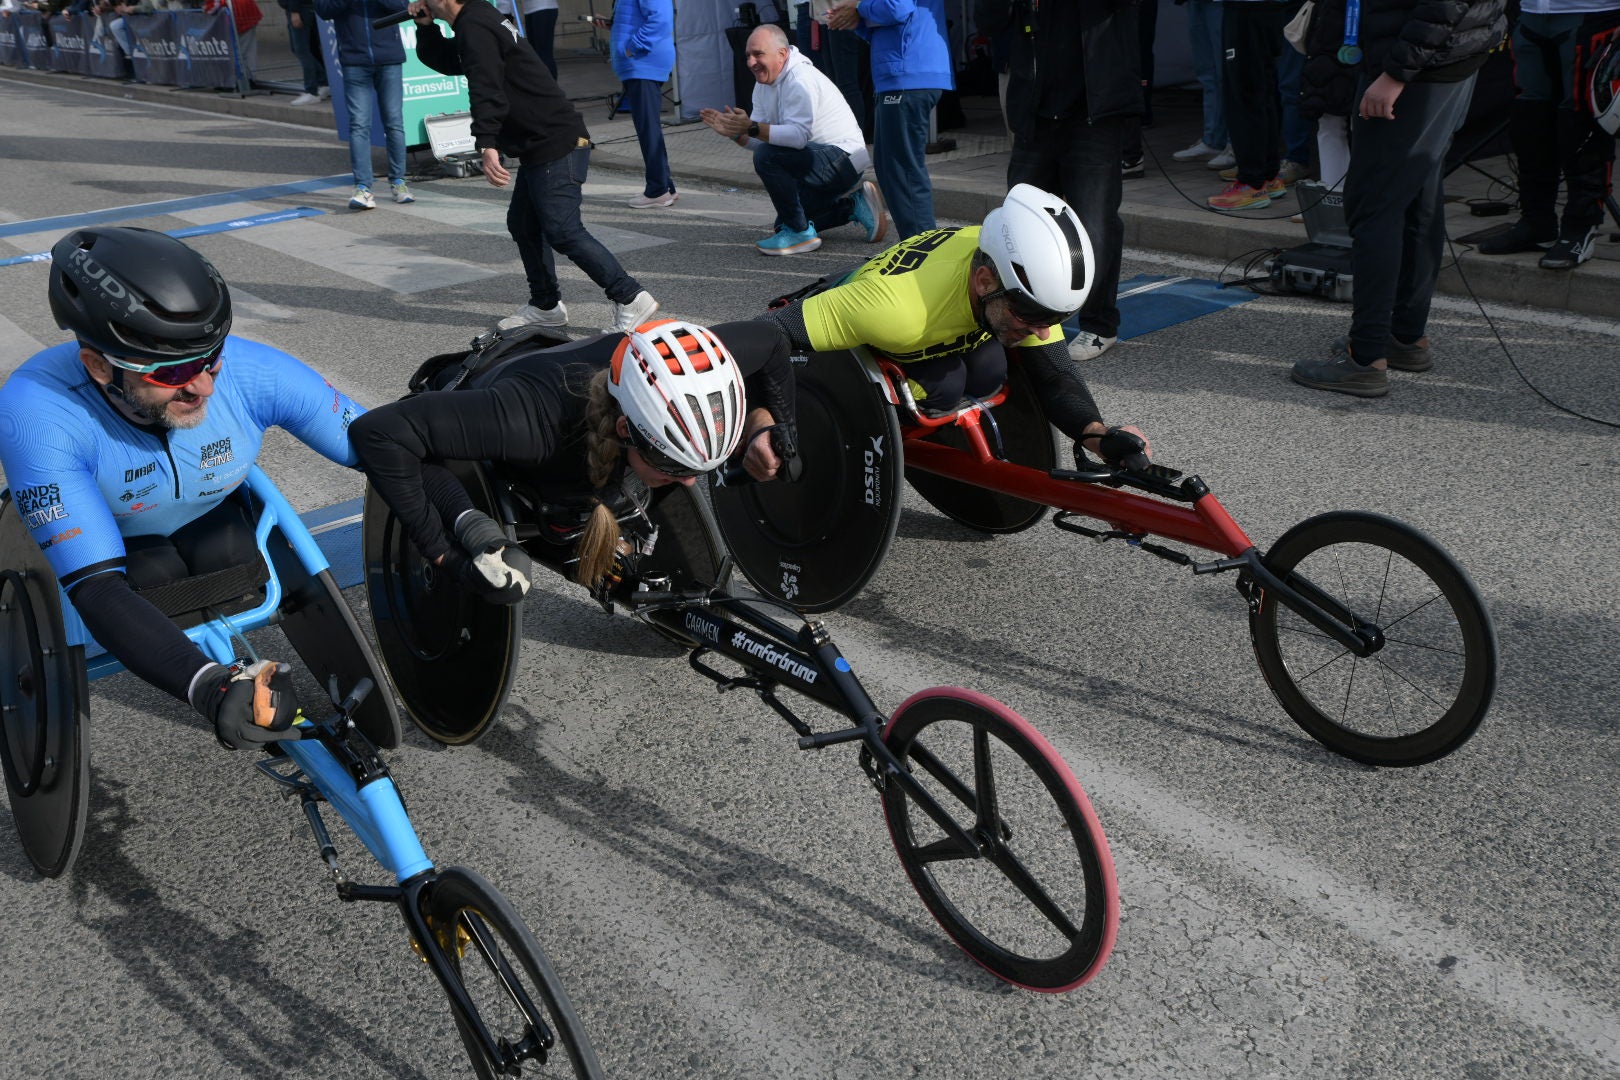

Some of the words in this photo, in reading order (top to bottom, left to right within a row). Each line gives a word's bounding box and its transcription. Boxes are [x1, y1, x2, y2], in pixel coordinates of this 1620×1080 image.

[403, 78, 454, 95] Transvia
[67, 262, 131, 319] PROJECT
[69, 248, 150, 313] RUDY
[201, 436, 231, 455] SANDS
[202, 444, 232, 461] BEACH
[15, 482, 60, 503] SANDS
[18, 492, 60, 515] BEACH
[685, 612, 720, 643] CARMEN
